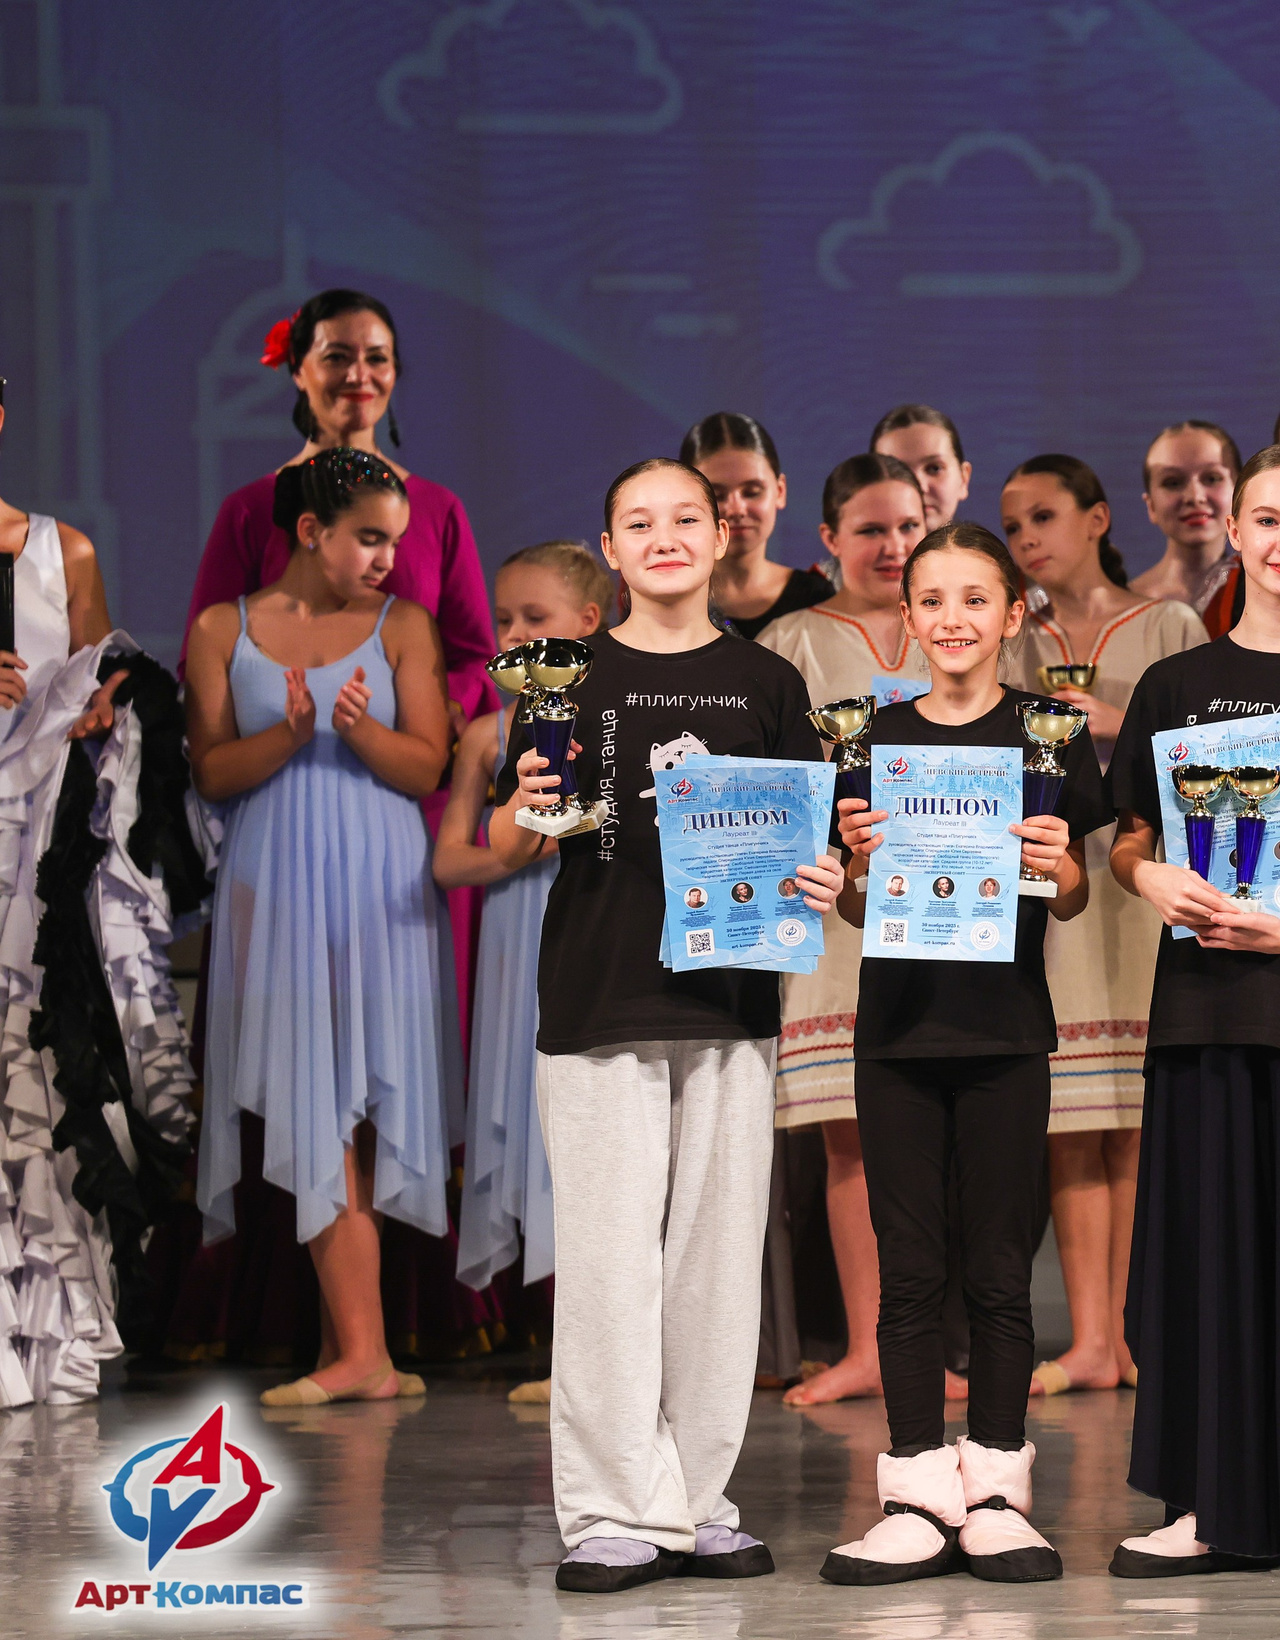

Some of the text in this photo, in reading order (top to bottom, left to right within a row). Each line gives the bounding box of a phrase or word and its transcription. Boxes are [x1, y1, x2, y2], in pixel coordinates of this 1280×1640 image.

[625, 692, 748, 711] #плигунчик
[597, 709, 619, 861] #студия_танца
[895, 797, 999, 818] ДИПЛОМ
[682, 810, 790, 835] ДИПЛОМ
